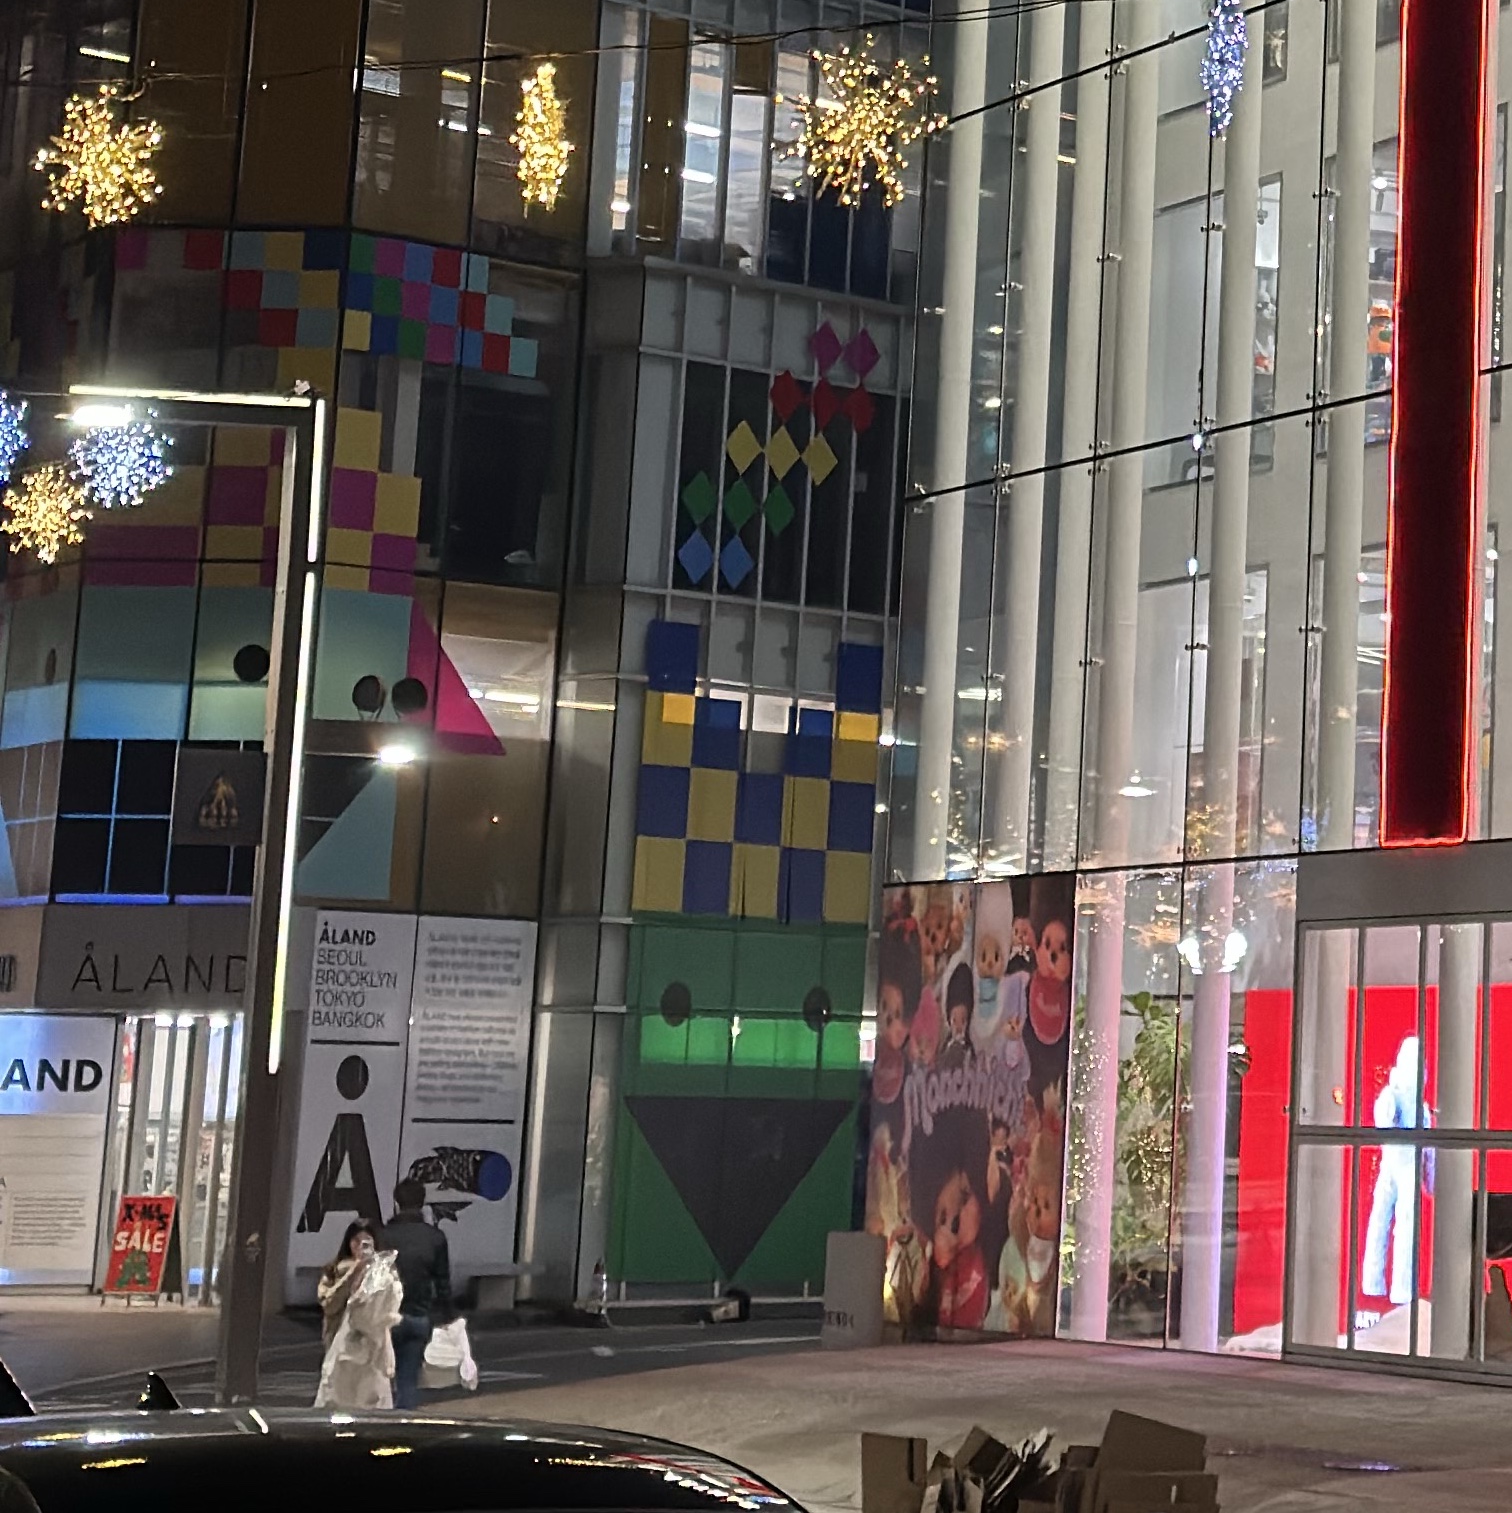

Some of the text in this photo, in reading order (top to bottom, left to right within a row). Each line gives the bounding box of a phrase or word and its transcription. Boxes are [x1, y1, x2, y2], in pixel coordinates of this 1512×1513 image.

[316, 949, 368, 966] SEOUL
[315, 969, 397, 988] BROOKLYN
[315, 989, 366, 1008] TOKYO
[312, 1011, 386, 1028] BANGKOK
